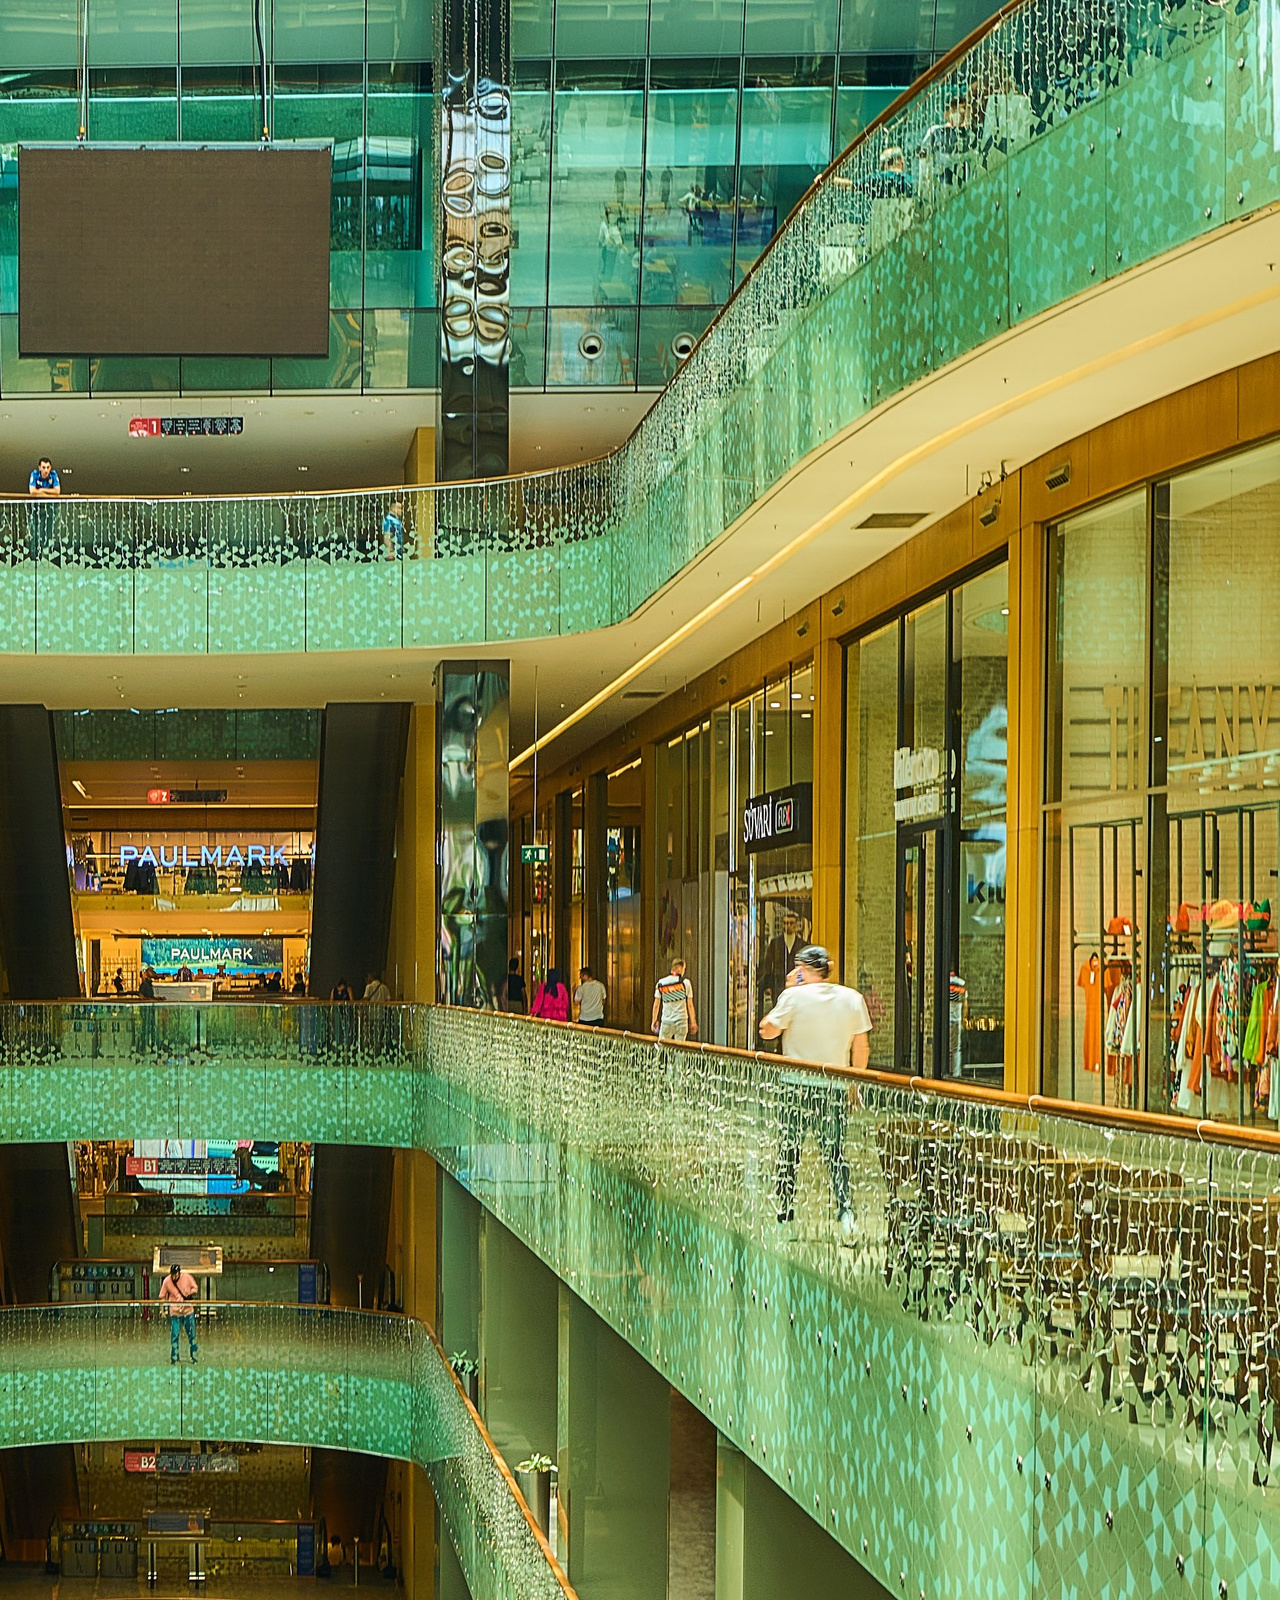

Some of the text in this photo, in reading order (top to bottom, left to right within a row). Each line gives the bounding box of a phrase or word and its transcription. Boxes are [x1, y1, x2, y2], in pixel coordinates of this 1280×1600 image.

[119, 844, 290, 868] PAULMARK
[170, 947, 254, 961] PAULMARK
[144, 1159, 156, 1172] B1
[141, 1456, 156, 1468] B2
